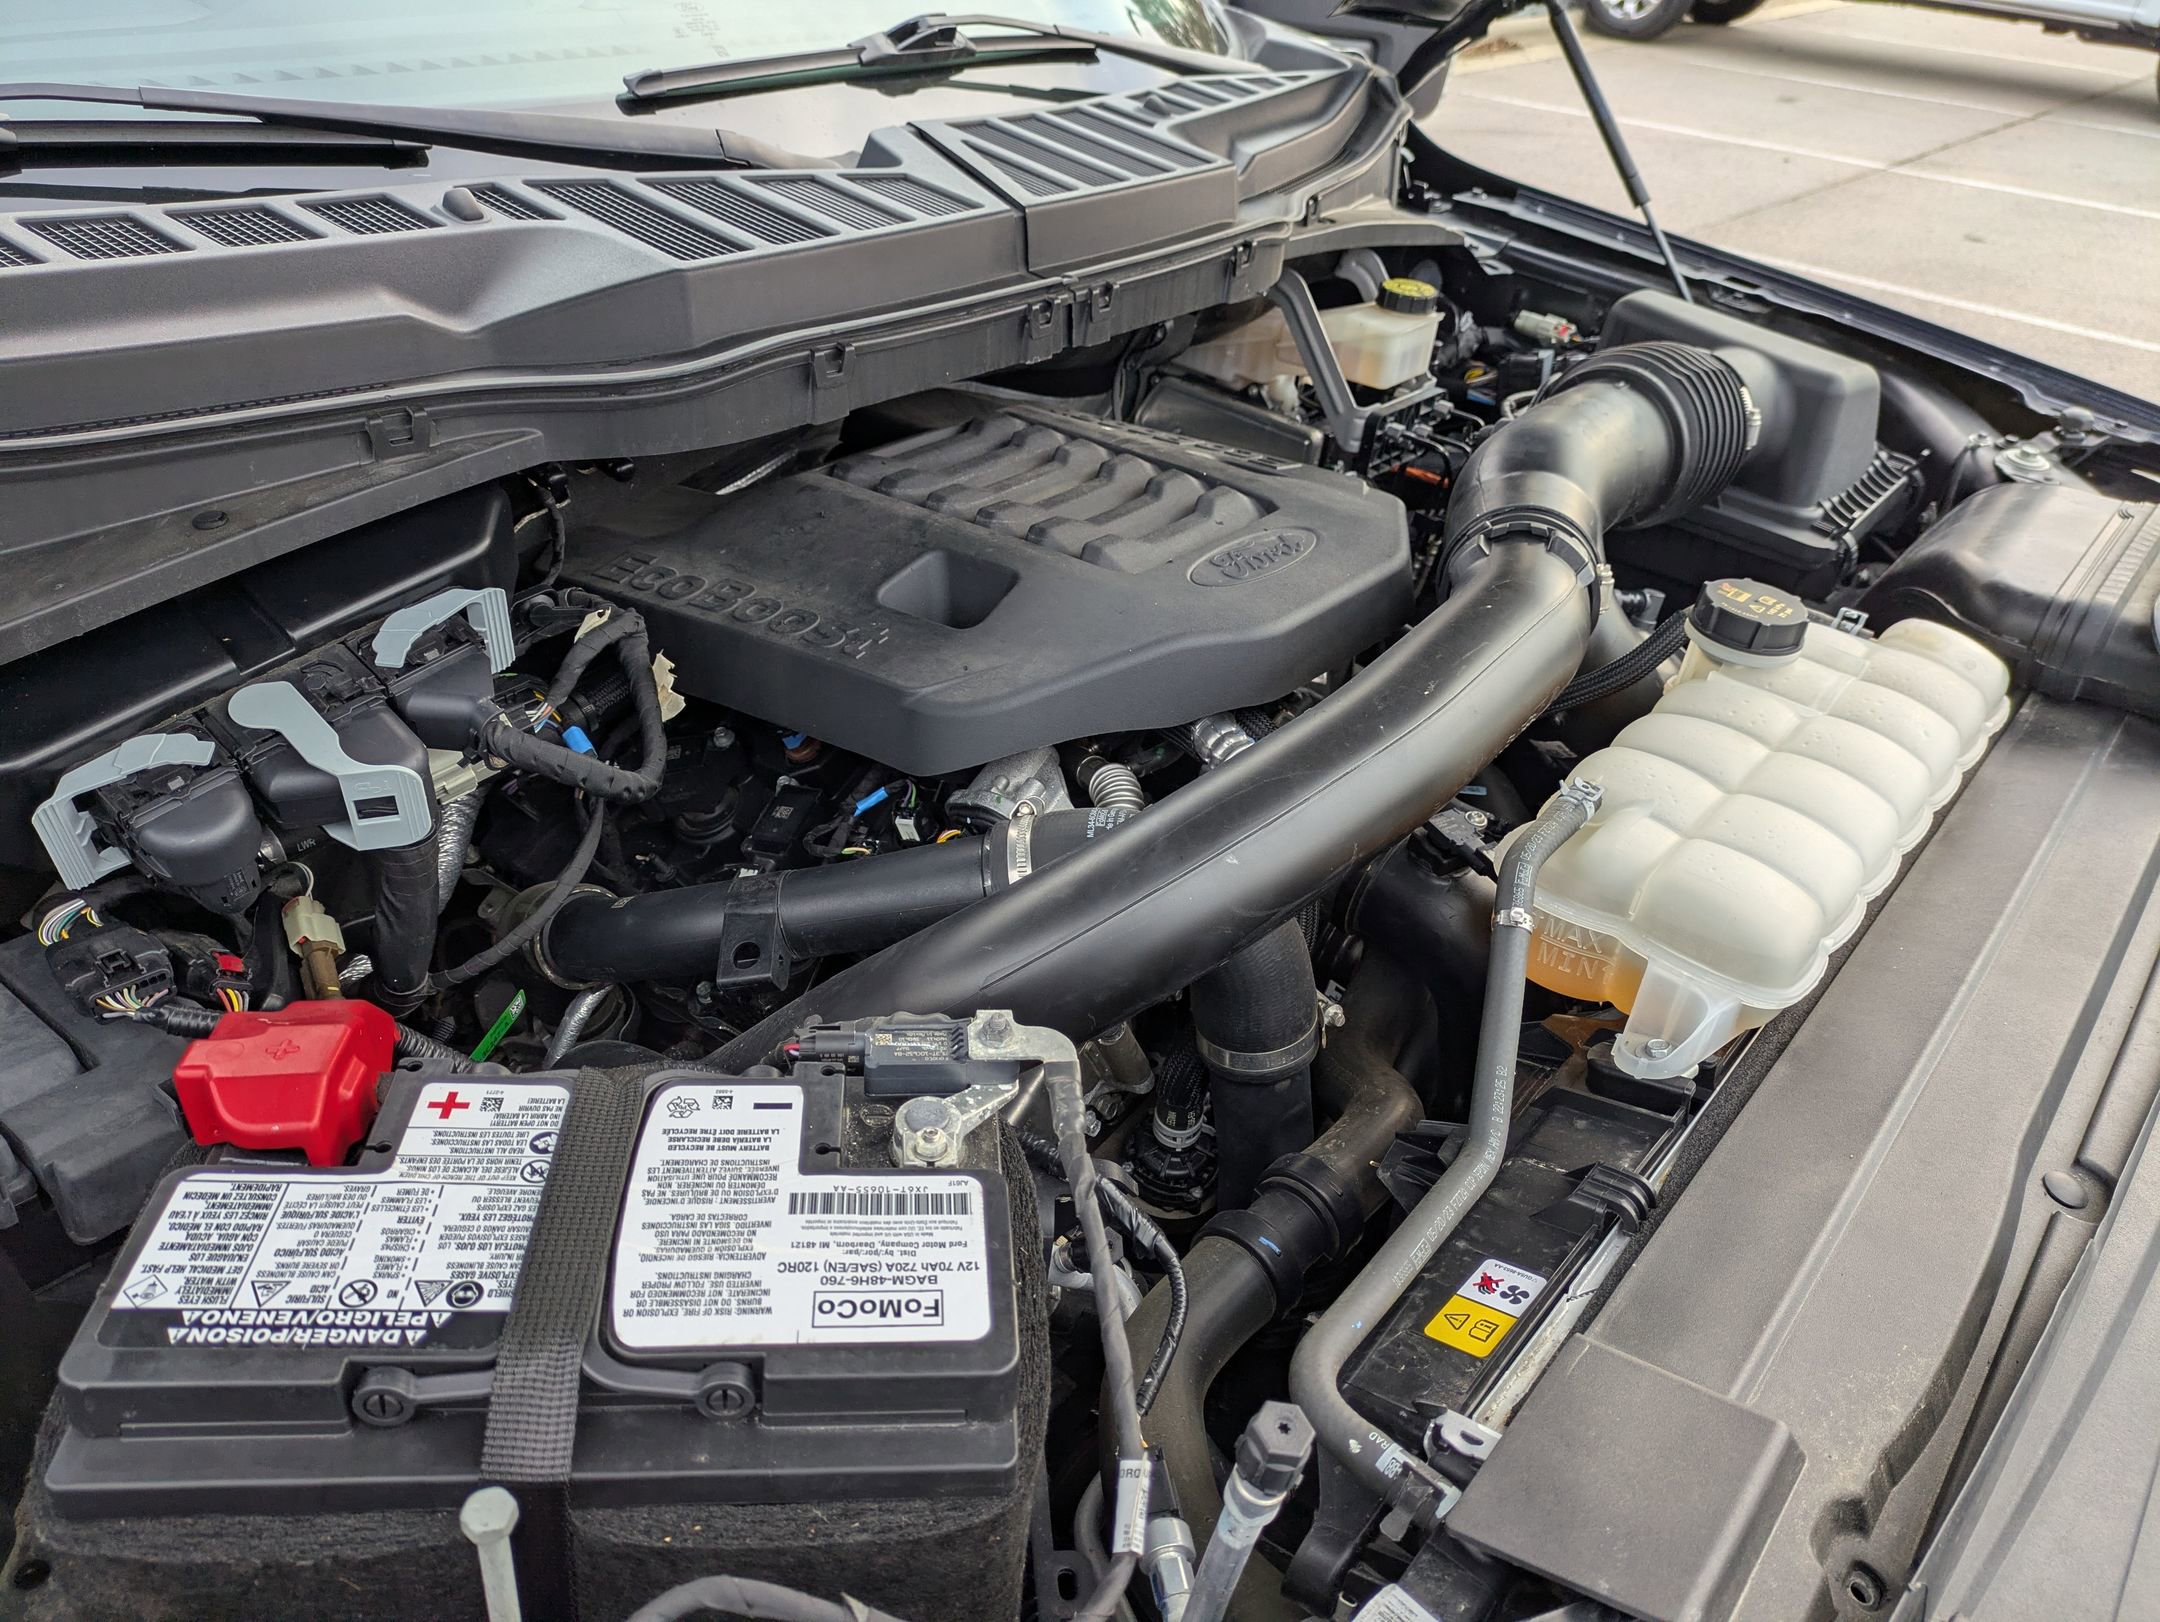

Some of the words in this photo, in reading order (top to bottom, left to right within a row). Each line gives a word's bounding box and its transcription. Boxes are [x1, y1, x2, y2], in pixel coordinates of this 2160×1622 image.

[296, 838, 316, 852] LWR
[1543, 918, 1602, 954] MAX
[1537, 941, 1600, 979] MIN
[231, 1183, 282, 1191] RAPIDEMENT.
[221, 1192, 234, 1201] UN
[234, 1192, 277, 1201] CONSULTEZ
[201, 1211, 223, 1219] YEUX
[224, 1211, 240, 1220] LES
[204, 1222, 214, 1231] EL
[214, 1222, 233, 1232] CON
[185, 1232, 214, 1241] ACUDA
[218, 1233, 241, 1241] AGUA.
[241, 1233, 258, 1242] CON
[158, 1242, 233, 1252] INMEDIATAMENTE
[233, 1243, 254, 1252] OJOS
[381, 1243, 410, 1251] CHISPAS
[791, 1241, 817, 1249] 48121
[819, 1241, 830, 1249] MI
[833, 1241, 876, 1249] Dearborn,
[879, 1241, 920, 1249] Company,
[189, 1253, 206, 1261] LOS
[207, 1253, 249, 1262] ENJUAGUE
[374, 1255, 406, 1263] SMOKING
[142, 1264, 165, 1273] FAST.
[165, 1264, 188, 1273] HELP
[189, 1264, 227, 1274] MEDICAL
[228, 1265, 243, 1274] GET
[778, 1262, 819, 1273] 120RC
[824, 1260, 883, 1272] (SAE/EN)
[886, 1260, 917, 1272] 720A
[921, 1260, 953, 1272] 70Ah
[958, 1260, 979, 1272] 12V
[373, 1271, 400, 1279] SPARKS
[451, 1271, 477, 1279] GASES
[656, 1272, 712, 1280] INSTRUCTIONS.
[714, 1271, 752, 1279] CHARGING
[184, 1277, 215, 1286] WATER.
[216, 1277, 237, 1286] WITH
[642, 1281, 673, 1289] PROPER
[674, 1281, 706, 1289] FOLLOW
[708, 1280, 725, 1288] USE.
[727, 1280, 762, 1288] INVERTED
[820, 1275, 937, 1286] BAGM-48H6-760
[175, 1286, 233, 1295] IMMEDIATELY
[310, 1285, 330, 1293] ACID
[727, 1289, 770, 1297] INCINERATE.
[631, 1290, 646, 1298] FOR
[648, 1290, 707, 1298] RECOMMENDED
[178, 1295, 202, 1304] EYES
[202, 1295, 229, 1304] FLUSH
[286, 1295, 326, 1304] SULFURIC
[637, 1299, 648, 1307] OR
[650, 1299, 702, 1307] DISASSEMBLE
[705, 1298, 719, 1306] NOT
[721, 1298, 732, 1306] DO
[735, 1298, 762, 1306] BURNS.
[623, 1308, 635, 1317] OR
[636, 1308, 680, 1316] EXPLOSION
[683, 1308, 701, 1316] FIRE,
[704, 1308, 713, 1316] OF
[715, 1307, 733, 1316] RISK
[735, 1307, 772, 1315] WARNING:
[818, 1298, 939, 1318] FoMoCo
[200, 1310, 429, 1326] PELIGRO/VENENO
[184, 1328, 402, 1344] DANGER/POISON
[1368, 1431, 1391, 1449] RAD
